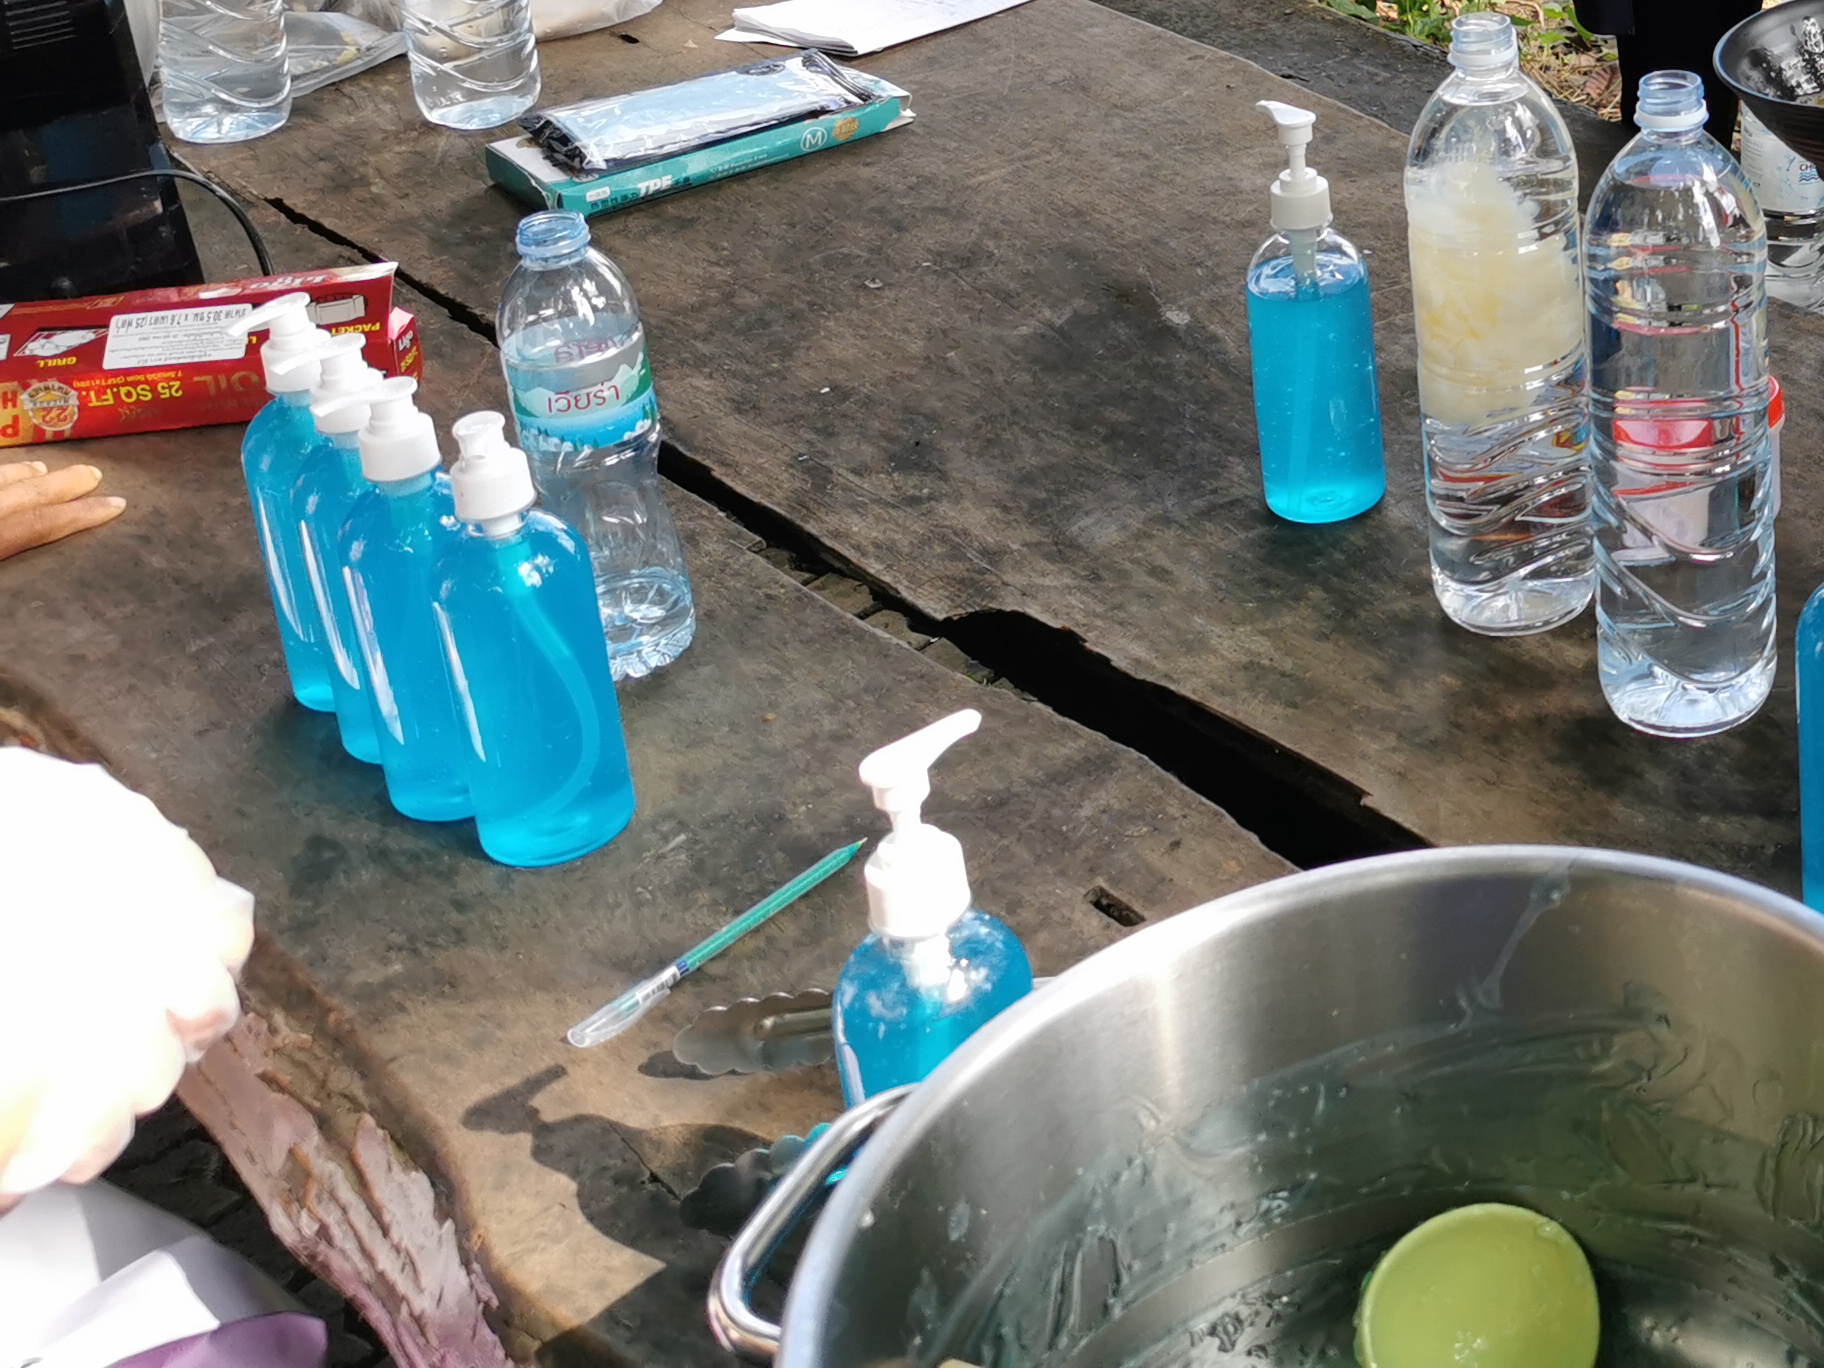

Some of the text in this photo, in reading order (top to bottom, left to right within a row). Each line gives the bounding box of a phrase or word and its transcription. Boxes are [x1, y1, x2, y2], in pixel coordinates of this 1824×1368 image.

[805, 131, 824, 149] M
[1799, 163, 1817, 173] CH
[637, 174, 673, 198] TPE
[331, 321, 380, 336] PACKET
[37, 356, 77, 369] GRILL
[160, 381, 184, 399] 25
[193, 371, 260, 398] OIL
[547, 382, 621, 413] เวียร่า
[41, 405, 69, 424] 22
